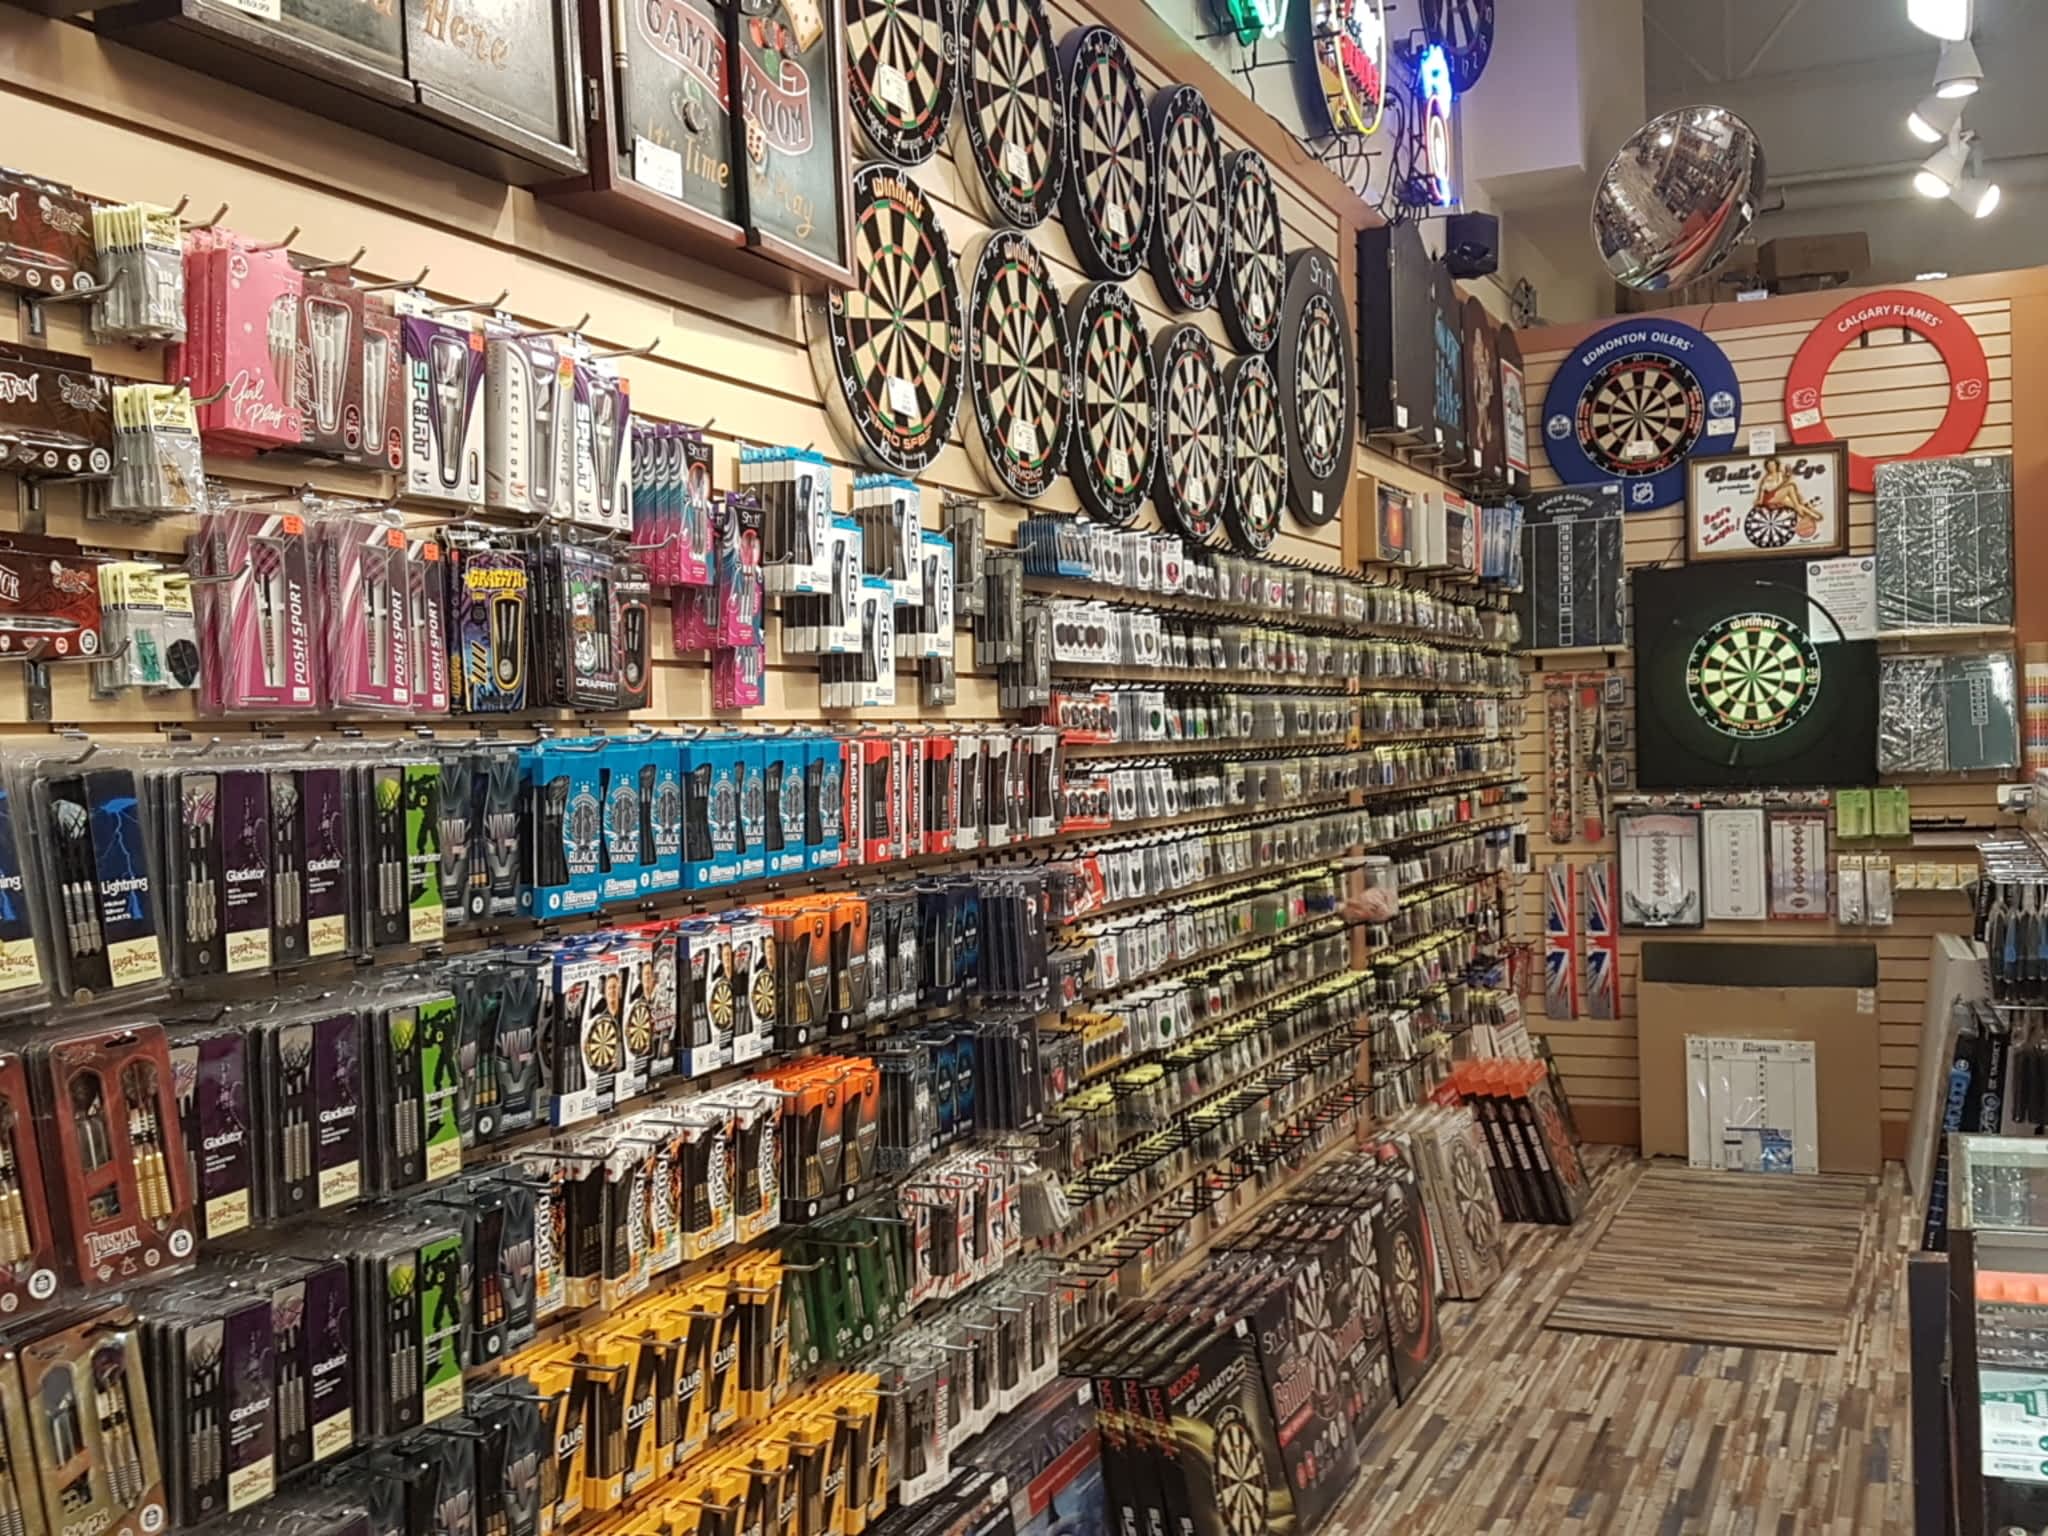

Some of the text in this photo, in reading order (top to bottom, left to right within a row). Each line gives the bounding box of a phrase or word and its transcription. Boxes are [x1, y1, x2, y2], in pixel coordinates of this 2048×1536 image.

[647, 0, 722, 91] GAME
[685, 133, 730, 188] Time
[872, 177, 925, 219] WINMAU
[1838, 304, 1940, 333] CALGARY FLAMES
[1582, 332, 1692, 367] EDMONTON OILERS
[509, 366, 518, 481] PRECISION
[1705, 459, 1826, 484] Bull's Eye
[288, 579, 306, 685] POSH SPORT
[1730, 617, 1781, 630] WINMAU
[391, 589, 407, 687] POSH SPORT
[428, 599, 444, 693] POSH SPORT
[850, 752, 858, 830] BLACK JACK
[610, 841, 639, 854] BLACK
[656, 832, 681, 845] BLACK
[713, 830, 736, 842] BLACK
[307, 858, 341, 872] Gladiator
[568, 851, 599, 863] BLACK
[568, 863, 595, 875] ARROW
[611, 853, 636, 863] ARROW
[101, 876, 148, 896] Lightning
[226, 868, 265, 882] Gladiator
[319, 1104, 357, 1123] Gladiator
[203, 1130, 243, 1150] Gladiator
[312, 1353, 348, 1377] Gladiator
[713, 1343, 737, 1368] CLUB
[677, 1369, 703, 1395] CLUB
[229, 1397, 272, 1423] Gladiator
[626, 1395, 655, 1424] CLUB
[558, 1424, 584, 1450] CLUB
